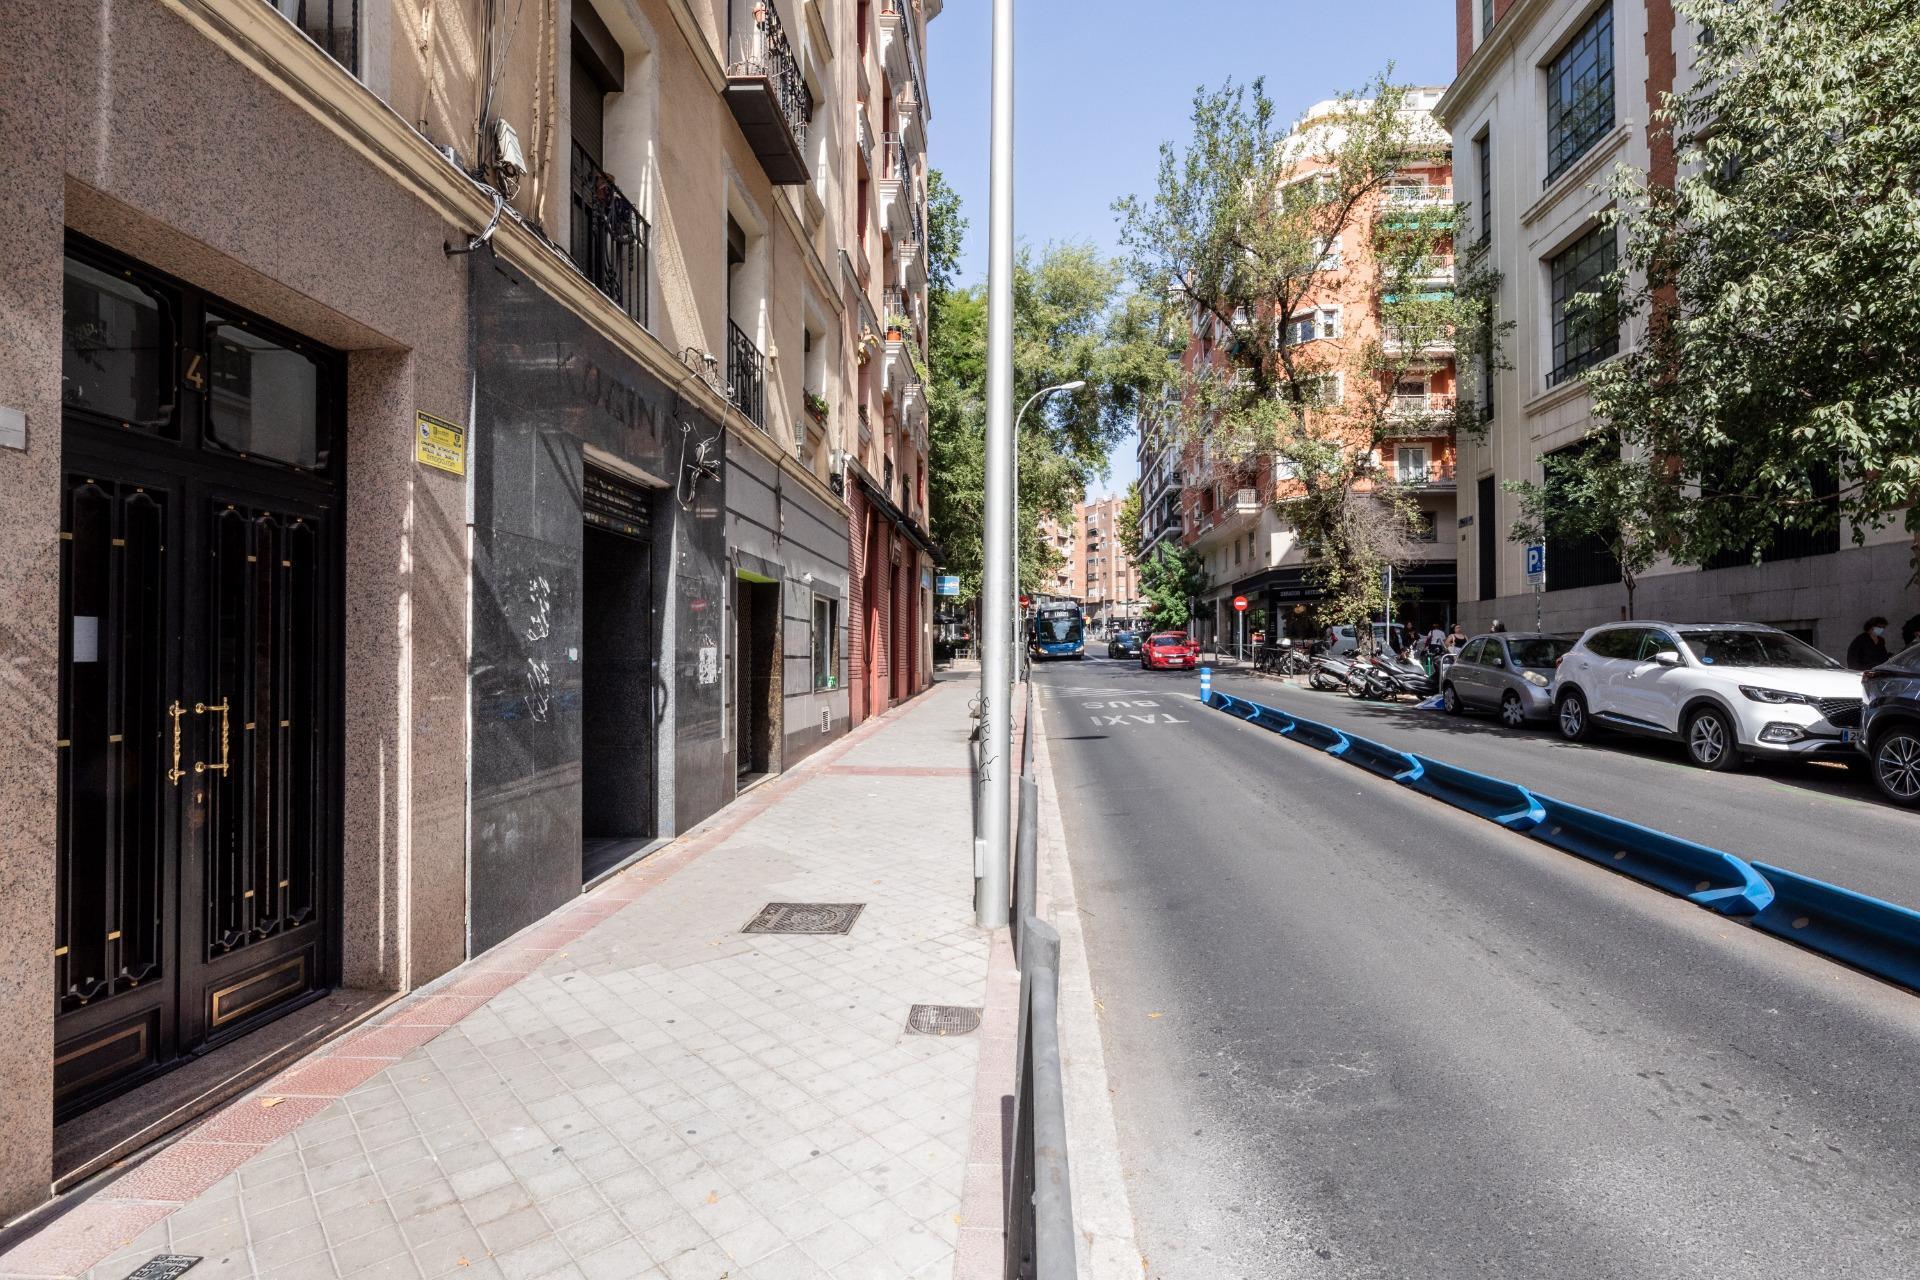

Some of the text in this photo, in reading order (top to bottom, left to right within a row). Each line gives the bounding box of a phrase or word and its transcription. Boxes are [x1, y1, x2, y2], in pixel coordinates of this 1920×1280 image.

[186, 354, 203, 389] 4
[1529, 550, 1539, 572] P
[1081, 700, 1161, 709] BUS
[1089, 713, 1190, 726] TAXI
